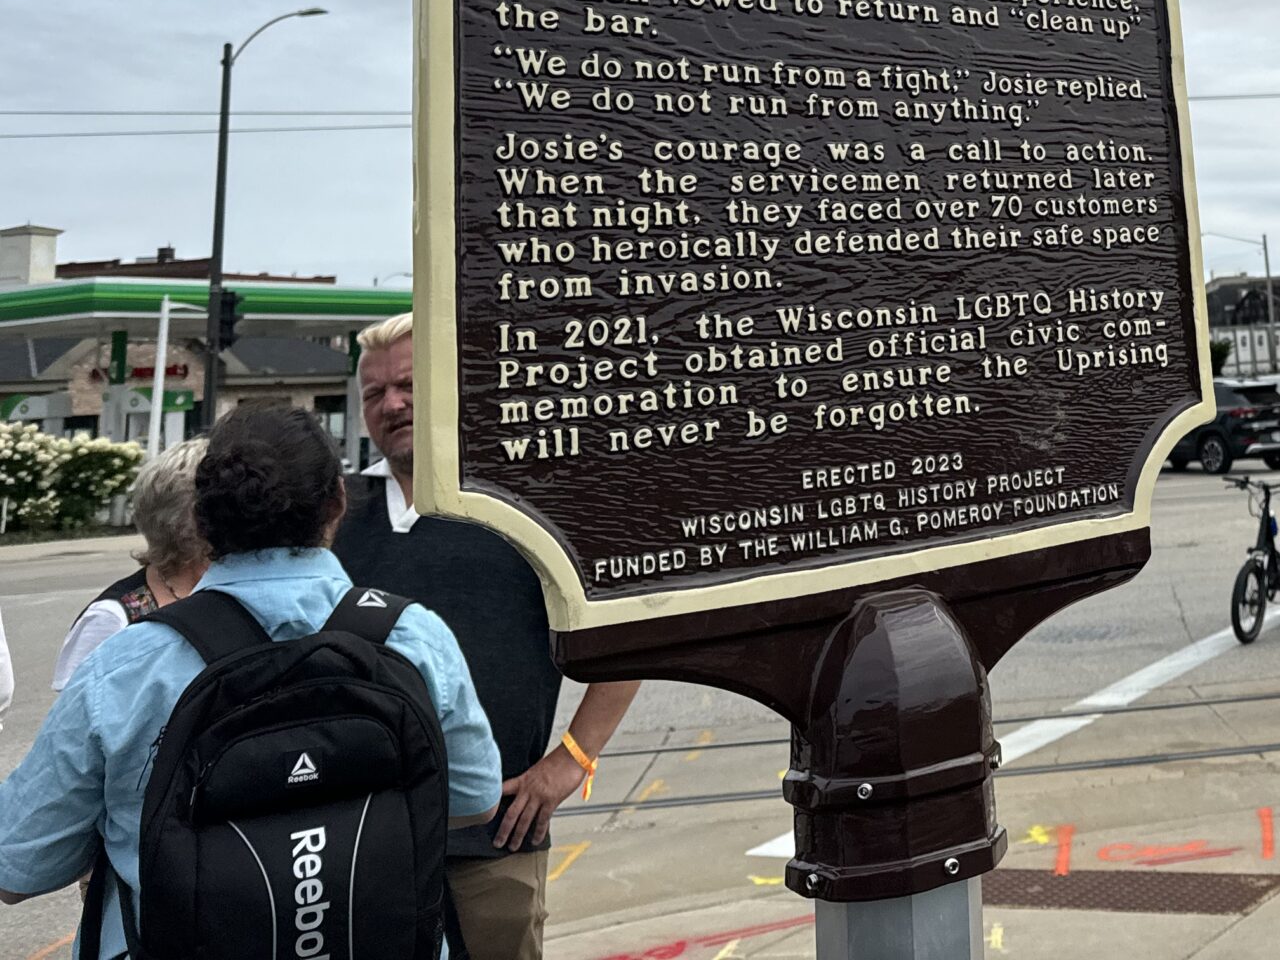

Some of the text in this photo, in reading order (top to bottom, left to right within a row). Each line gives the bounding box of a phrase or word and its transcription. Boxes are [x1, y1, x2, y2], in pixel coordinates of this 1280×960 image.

[592, 86, 634, 111] do
[654, 89, 712, 113] not
[729, 95, 788, 116] run
[805, 92, 879, 118] from
[654, 140, 802, 168] courage
[826, 141, 885, 161] was
[910, 142, 926, 161] a
[948, 138, 1003, 161] call
[1020, 139, 1047, 161] to
[1066, 139, 1153, 162] action.
[496, 167, 1155, 195] When the servicemen returned later
[496, 193, 1158, 234] that night, they faced over 70 customers
[497, 223, 1160, 263] who heroically defended their safe space
[497, 270, 783, 300] from invasion.
[499, 287, 1165, 353] In 2021, the Wisconsin LGBTQ History
[498, 319, 1167, 390] Project obtained official civic com-
[499, 341, 1169, 424] memoration to ensure the Uprising
[501, 392, 981, 461] will never be forgotten.
[802, 452, 963, 490] ERECTED 2023
[681, 466, 1066, 538] WISCONSIN LGBTQ HISTORY PROJECT
[594, 483, 1119, 582] FUNDED BY THE WILLIAM G. POMEROY FOUNDATION
[287, 772, 319, 784] Reebok
